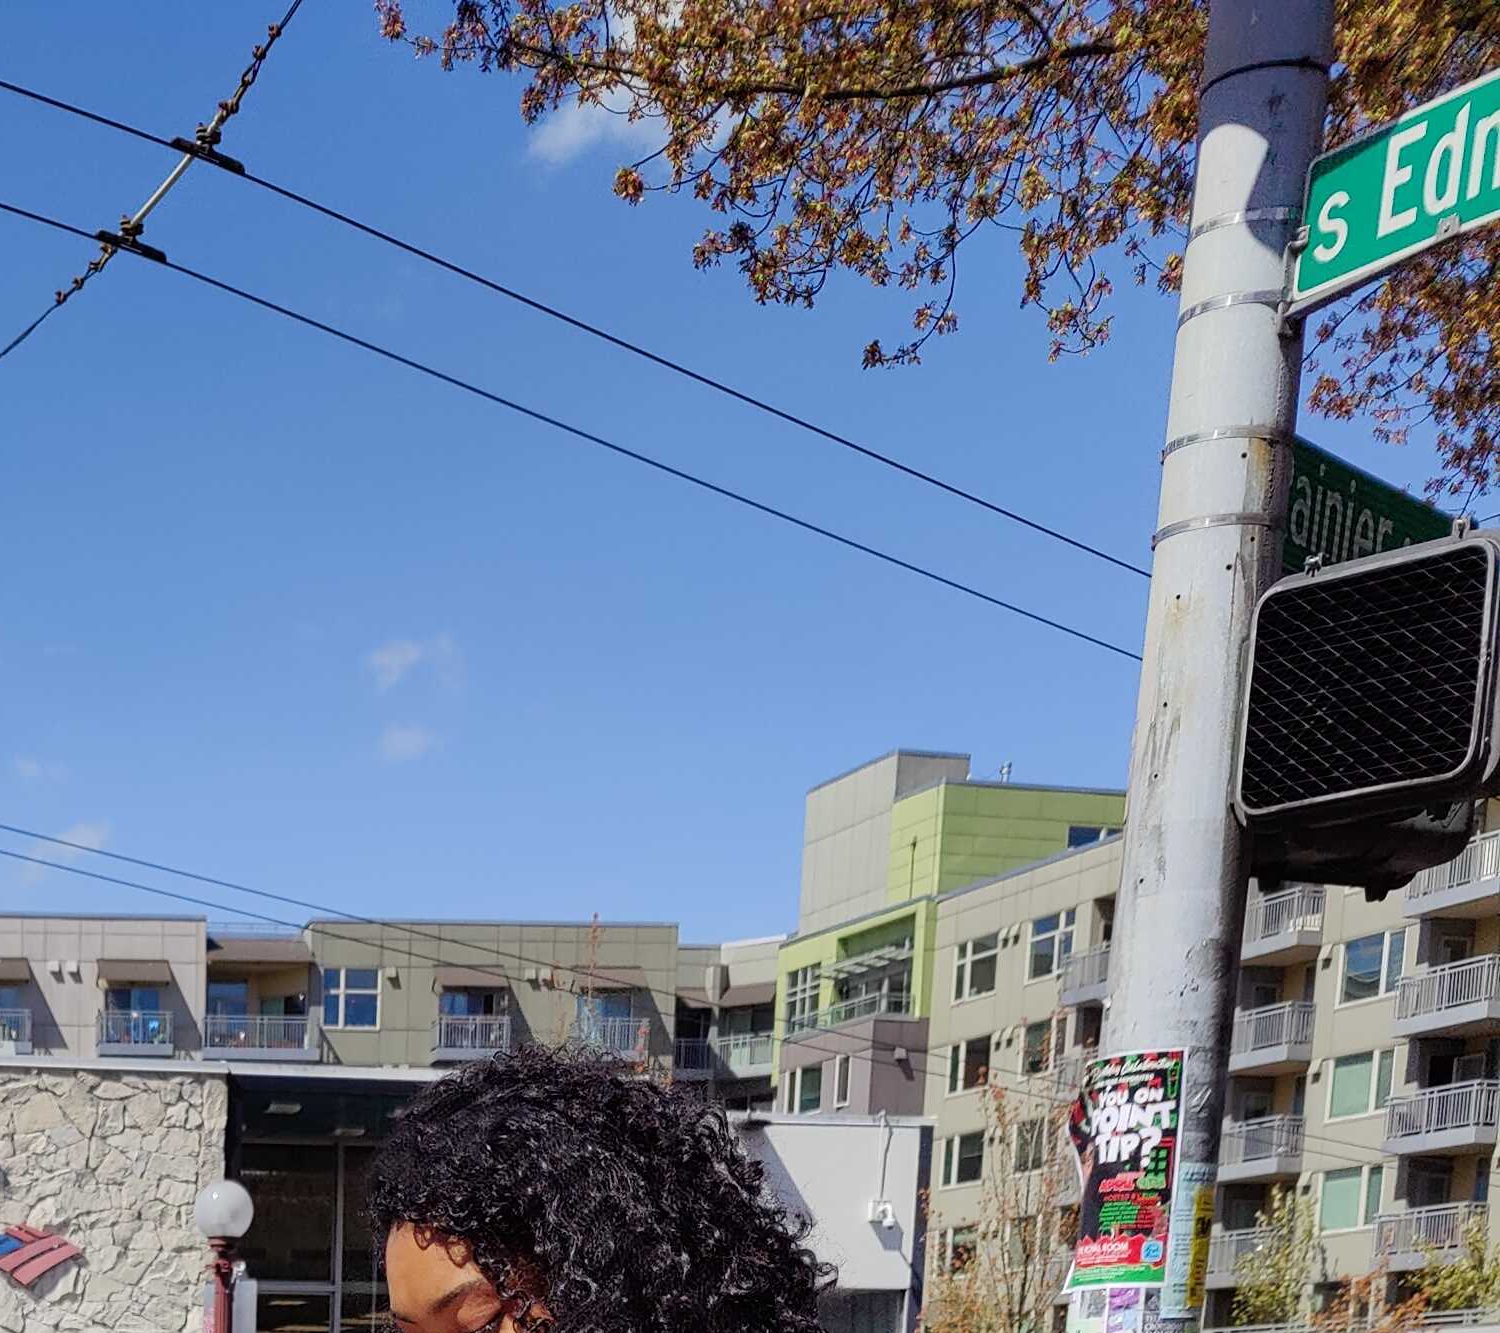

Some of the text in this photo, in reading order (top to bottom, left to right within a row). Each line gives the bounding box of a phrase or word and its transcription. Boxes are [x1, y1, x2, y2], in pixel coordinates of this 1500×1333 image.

[1313, 190, 1350, 263] S
[1290, 463, 1393, 563] ainier
[1095, 1127, 1162, 1167] TIP?
